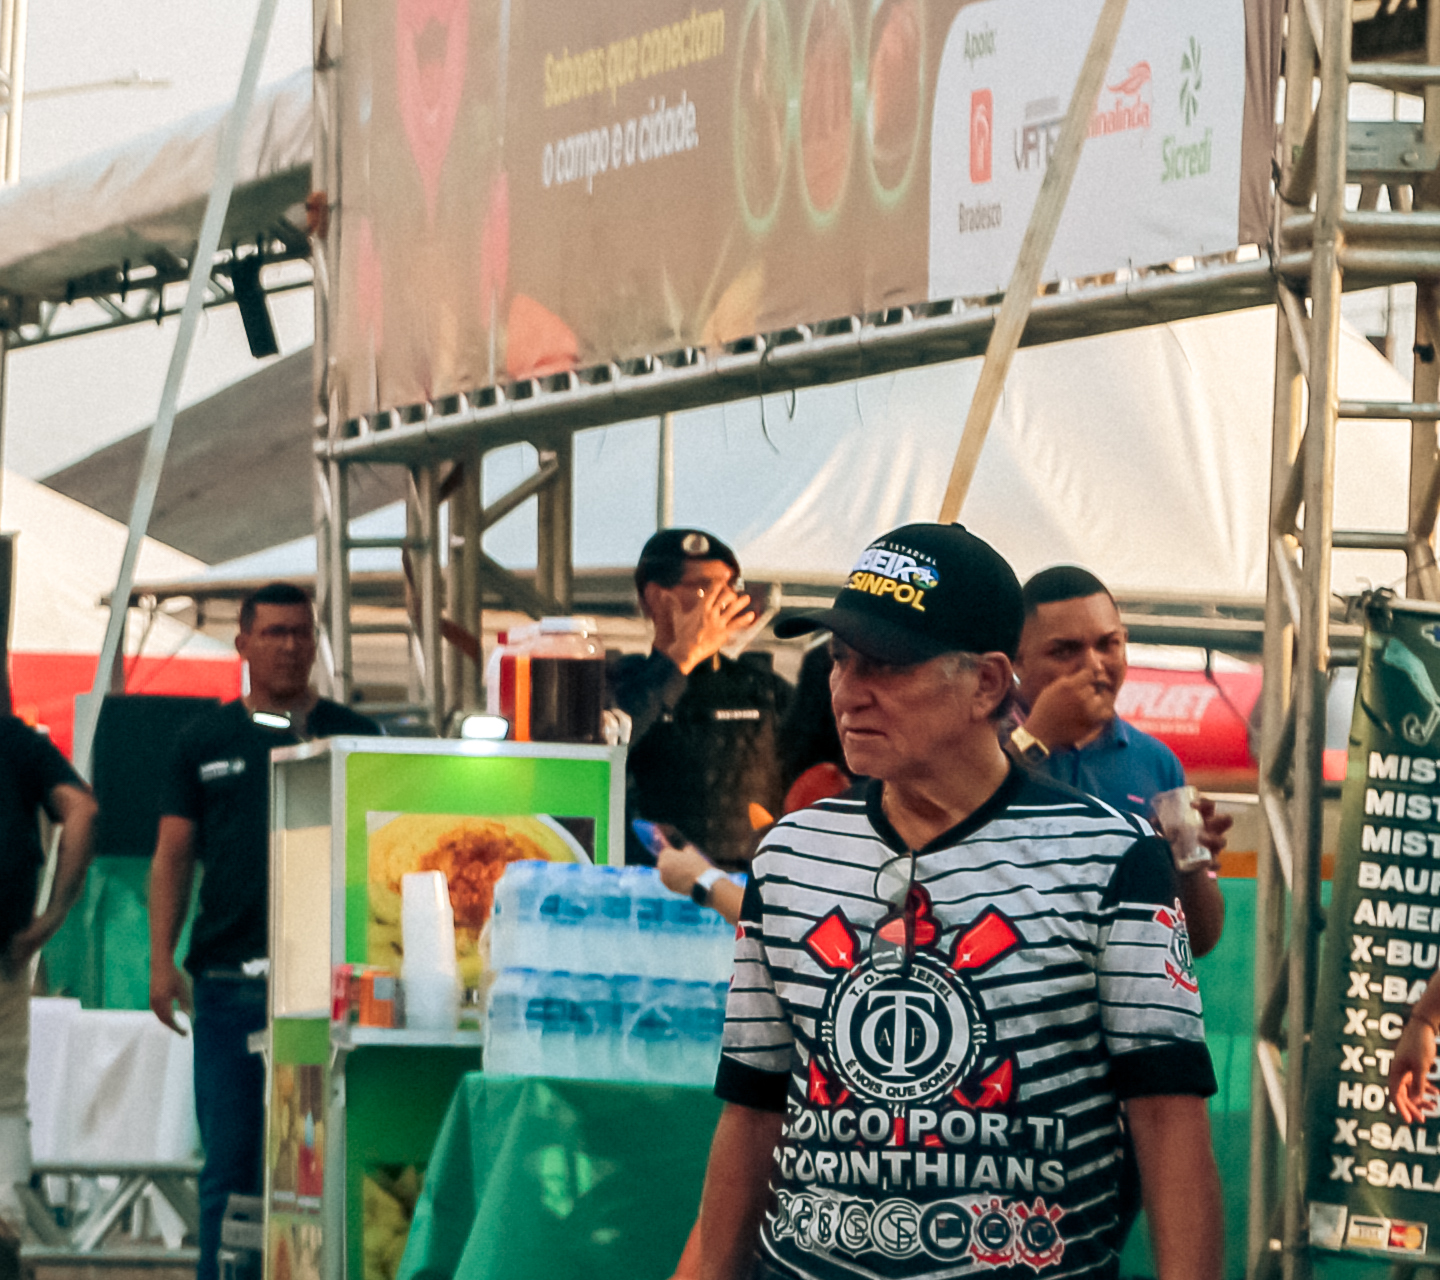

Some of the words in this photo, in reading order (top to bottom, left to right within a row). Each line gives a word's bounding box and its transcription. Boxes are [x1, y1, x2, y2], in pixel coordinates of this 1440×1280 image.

[606, 36, 638, 107] que
[640, 7, 725, 79] conectam
[542, 142, 554, 188] o
[556, 126, 610, 195] campo
[611, 122, 623, 170] e
[624, 118, 637, 166] a
[1162, 125, 1213, 183] Sicredi
[959, 201, 1002, 234] Bradesco
[848, 571, 926, 612] SINPOL
[1368, 750, 1440, 784] MIS
[885, 1085, 918, 1099] QUE
[919, 1061, 957, 1094] SOMA
[909, 1109, 1009, 1147] POR
[1027, 1116, 1065, 1151] TI
[780, 1145, 1065, 1193] CORINTHIANS
[1330, 1154, 1440, 1192] X-SAL
